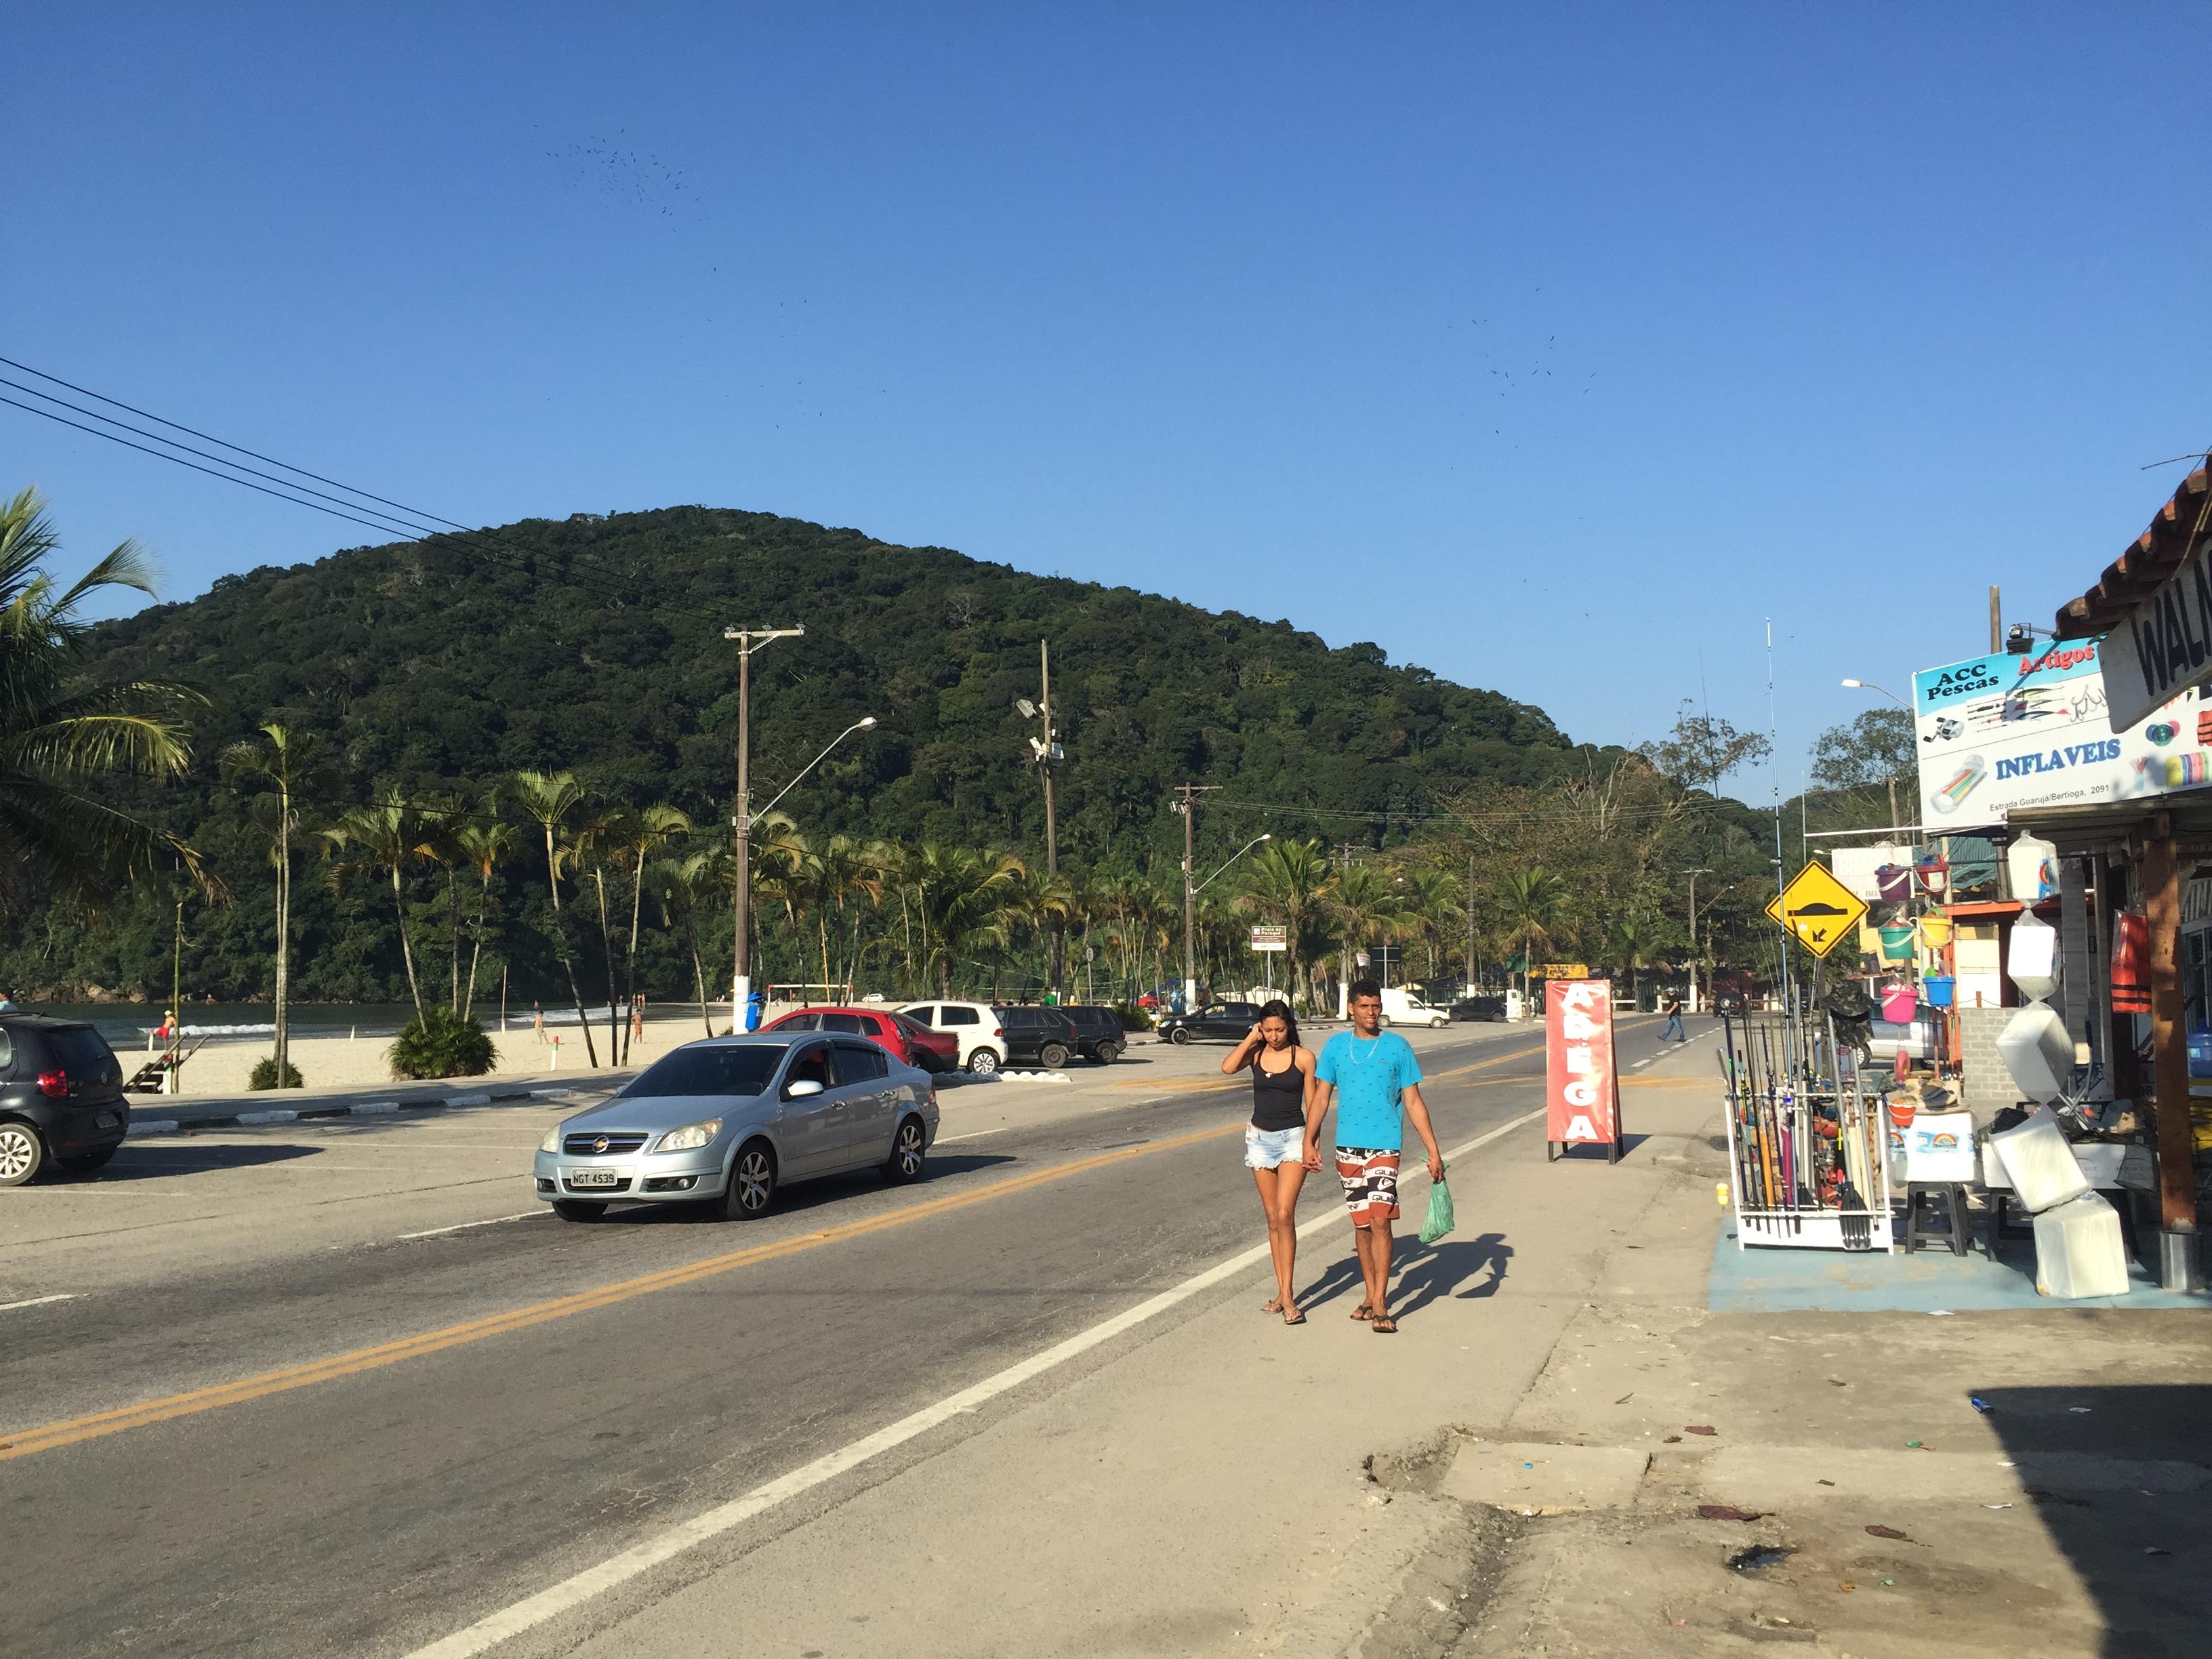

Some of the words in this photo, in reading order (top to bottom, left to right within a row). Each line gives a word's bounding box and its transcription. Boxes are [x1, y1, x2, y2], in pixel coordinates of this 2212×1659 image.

[2018, 646, 2095, 676] Artigos
[1927, 676, 1999, 701] Pescas
[1937, 664, 1986, 687] ACC
[1996, 739, 2121, 780] INFLAVEIS
[1990, 800, 2018, 811] Estrada
[2091, 784, 2109, 794] 2091
[1561, 982, 1599, 1140] ADEGA
[573, 1174, 589, 1183] NGT
[592, 1174, 614, 1183] 4539
